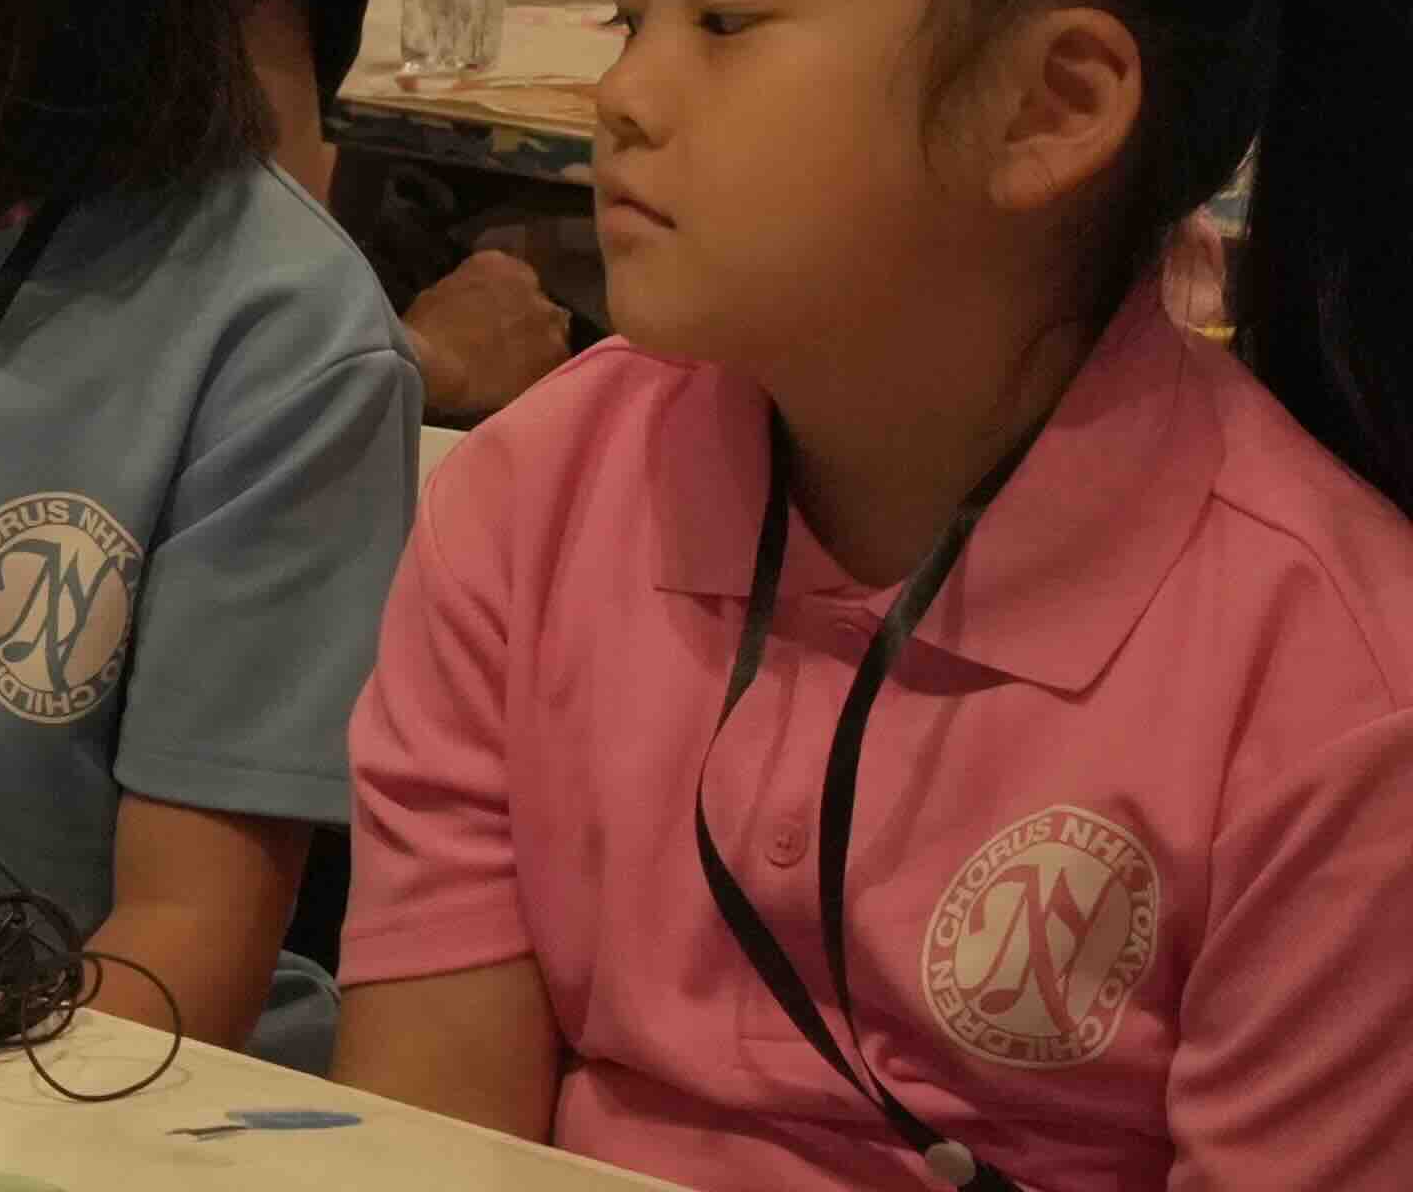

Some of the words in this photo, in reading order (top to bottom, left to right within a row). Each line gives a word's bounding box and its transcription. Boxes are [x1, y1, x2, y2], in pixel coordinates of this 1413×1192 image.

[78, 506, 138, 571] NHK
[934, 816, 1054, 948] CHORUS
[1059, 817, 1147, 887] NHK
